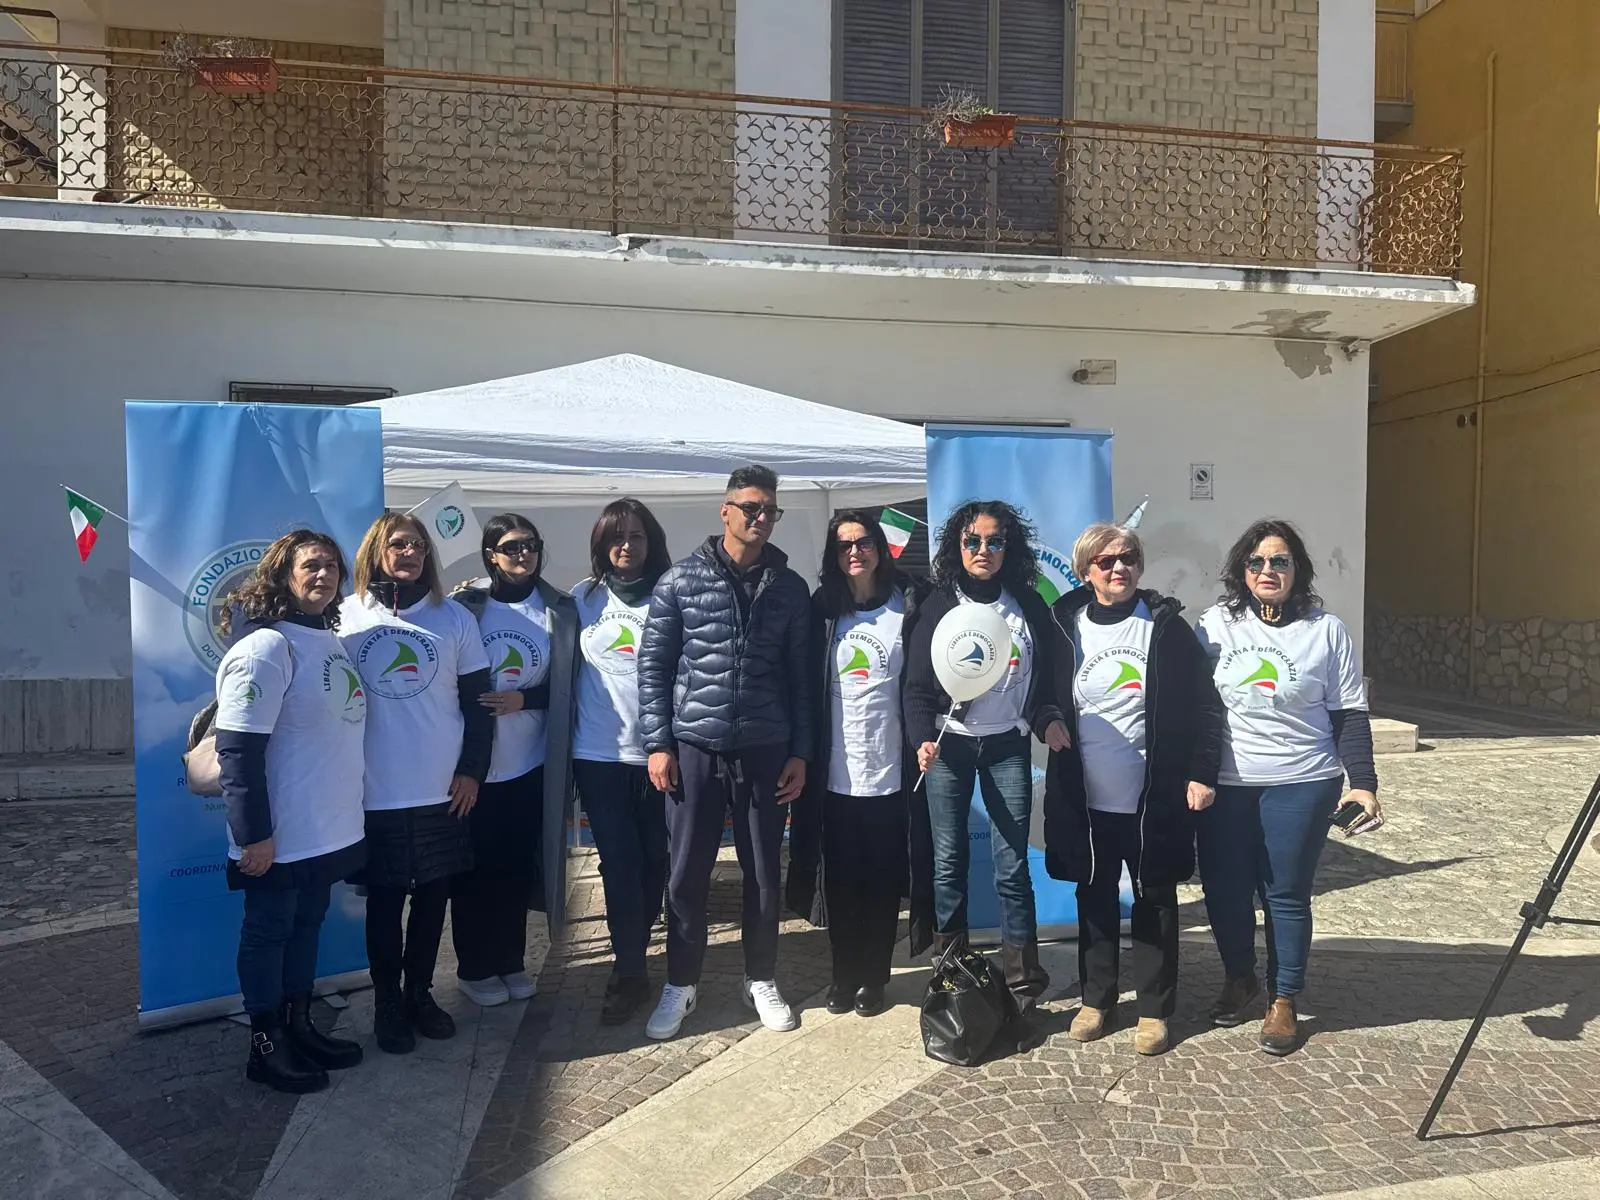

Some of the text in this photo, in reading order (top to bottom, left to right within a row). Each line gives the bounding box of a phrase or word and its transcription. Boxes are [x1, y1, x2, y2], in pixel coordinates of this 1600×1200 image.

[390, 628, 436, 663] DEMOCRAZIA
[503, 632, 539, 667] DEMOCRAZIA
[849, 633, 887, 669] DEMOCRAZIA
[1257, 646, 1297, 682] DEMOCRAZIA
